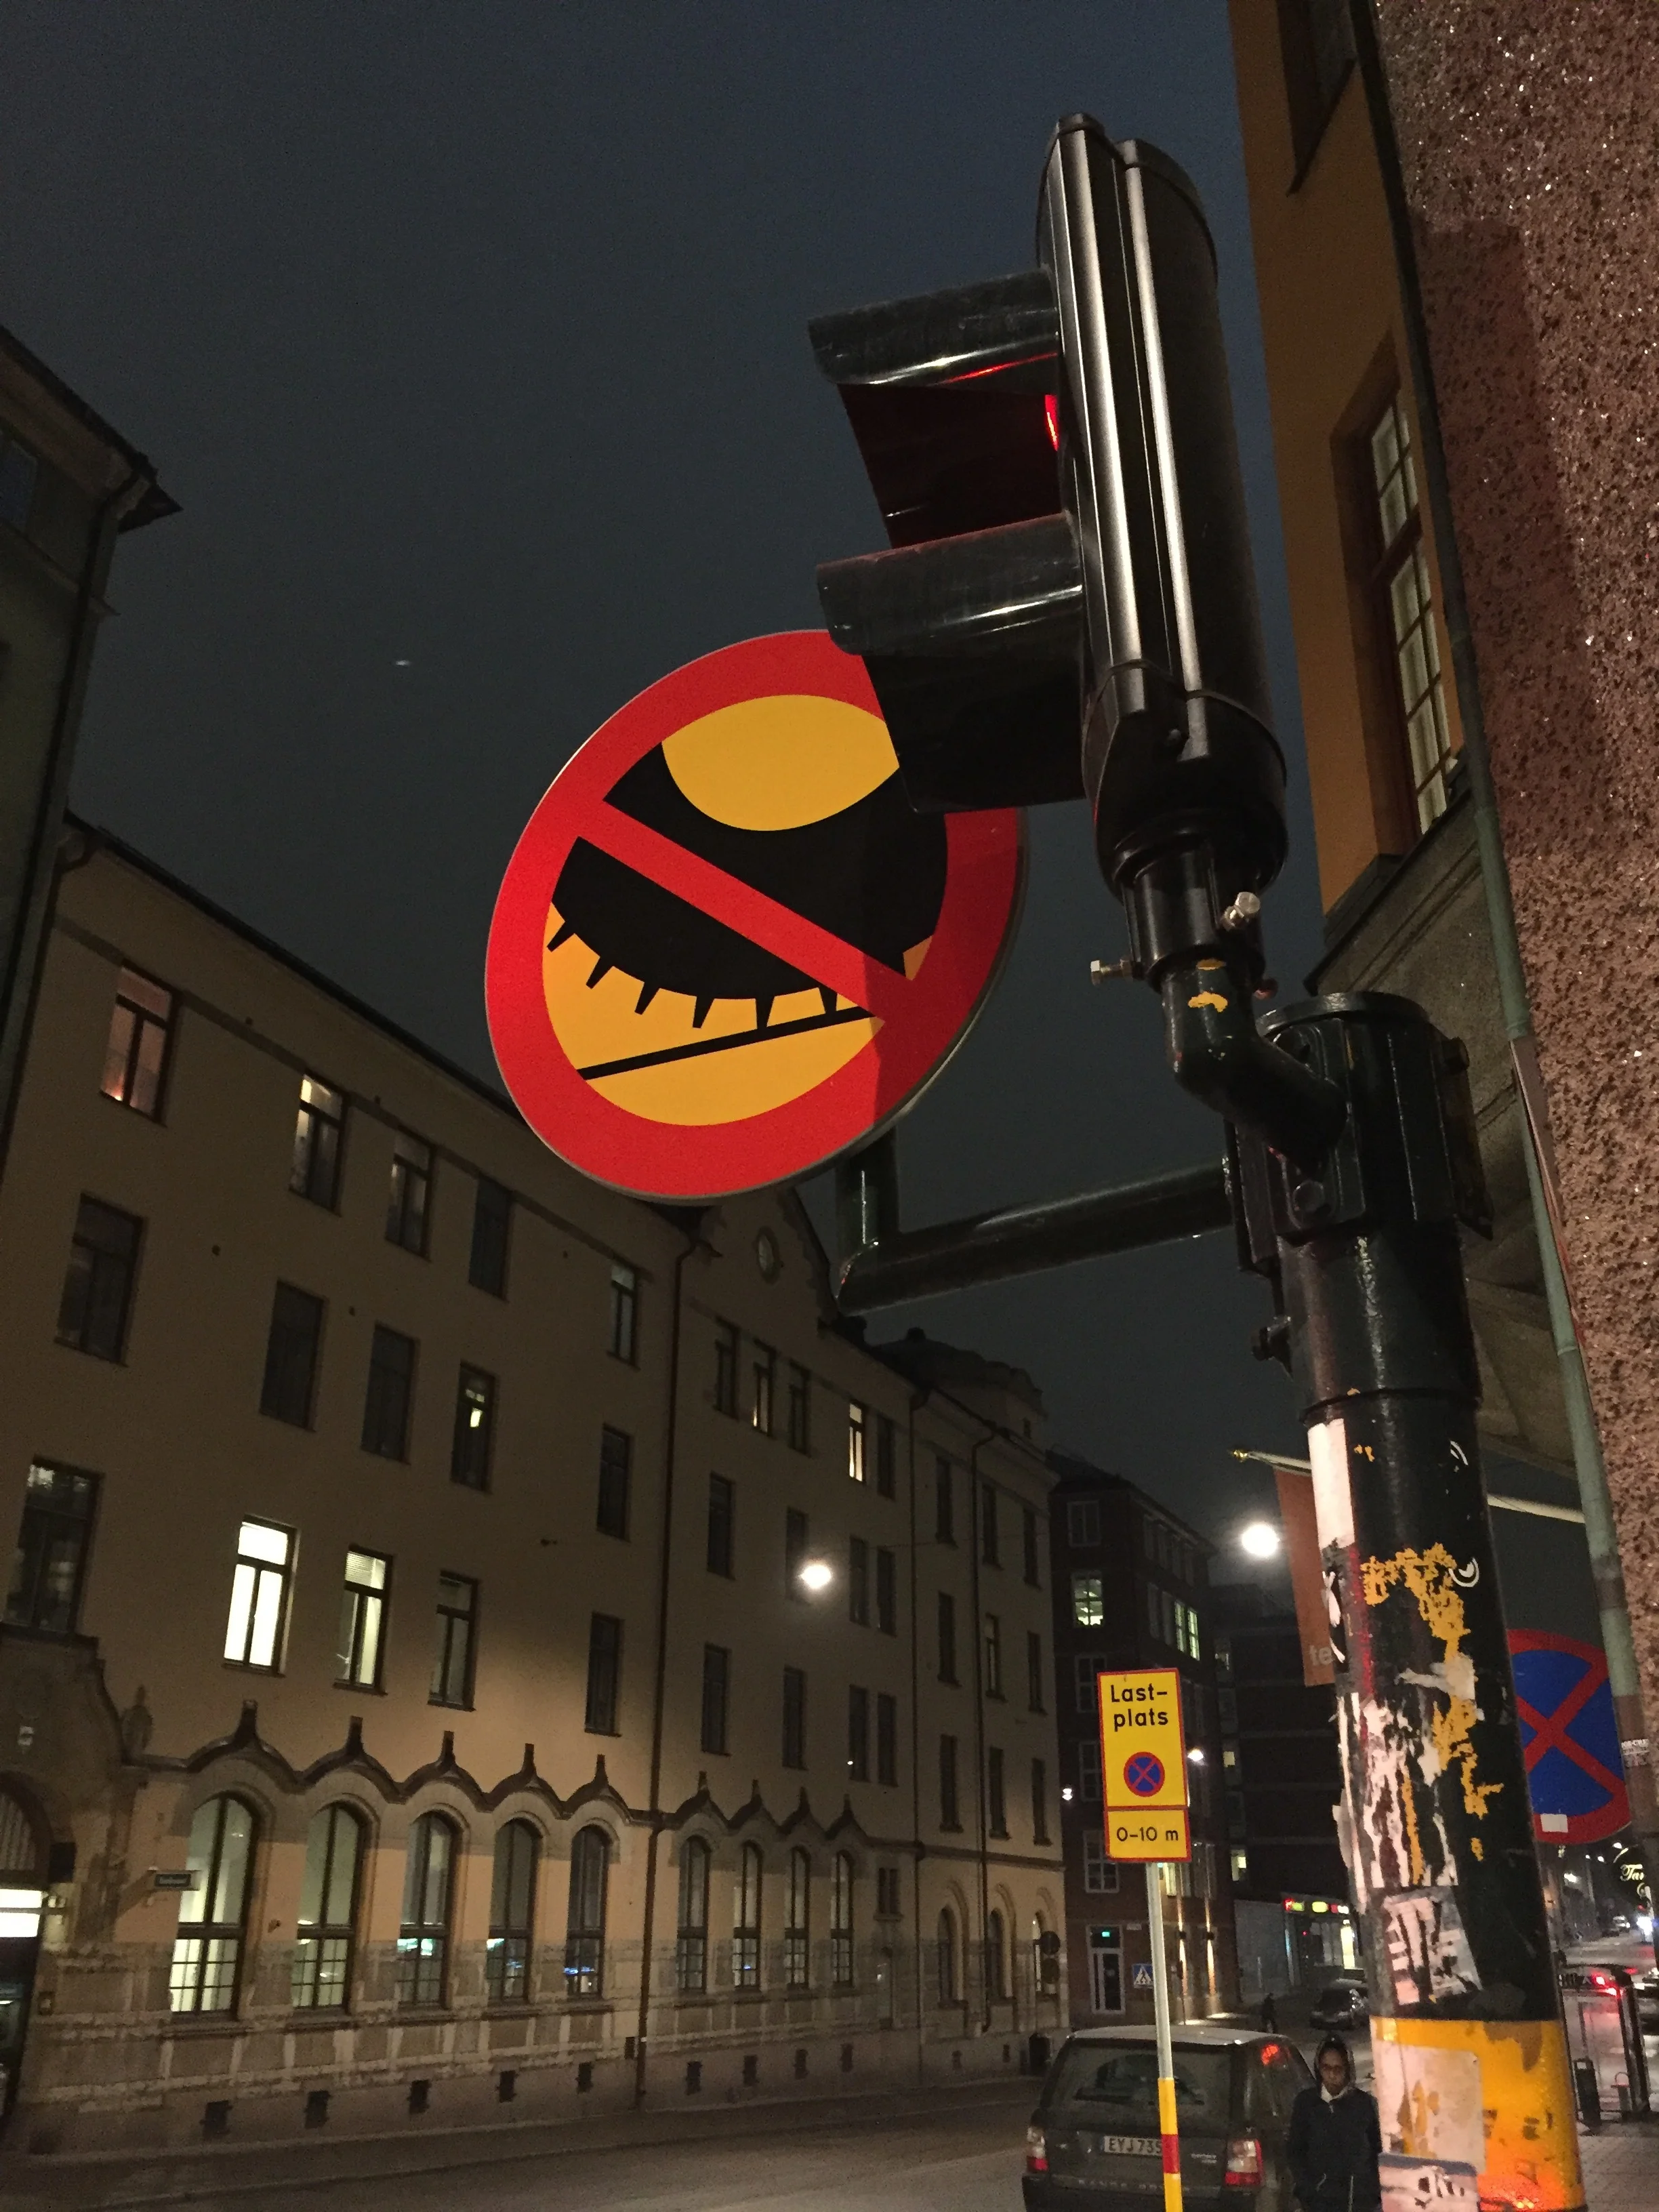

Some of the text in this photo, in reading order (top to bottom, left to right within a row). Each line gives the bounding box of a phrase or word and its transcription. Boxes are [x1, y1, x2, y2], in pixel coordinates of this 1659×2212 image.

[1111, 1683, 1168, 1702] Last-
[1114, 1708, 1168, 1732] plats
[1117, 1826, 1179, 1841] 0-10 m
[1109, 2137, 1134, 2152] EYJ
